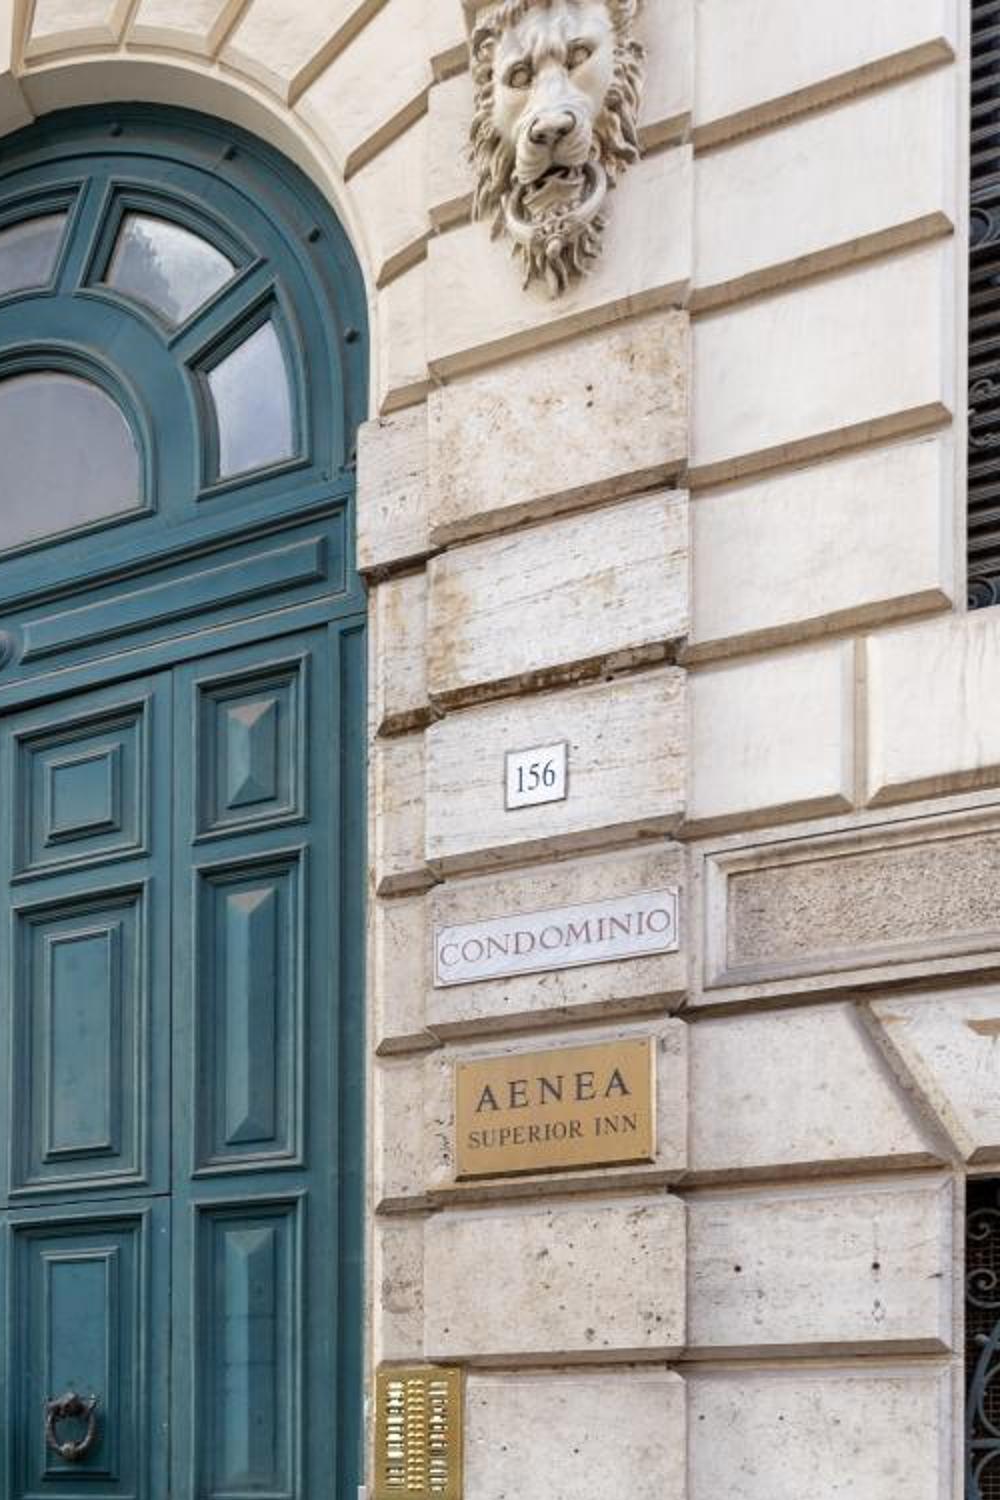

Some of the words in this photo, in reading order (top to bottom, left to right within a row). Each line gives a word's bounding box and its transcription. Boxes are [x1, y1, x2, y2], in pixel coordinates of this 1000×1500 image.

[515, 761, 557, 794] 156
[439, 907, 671, 967] CONDOMINIO
[475, 1068, 632, 1113] AENEA
[467, 1119, 583, 1150] SUPERIOR
[594, 1113, 638, 1134] INN
